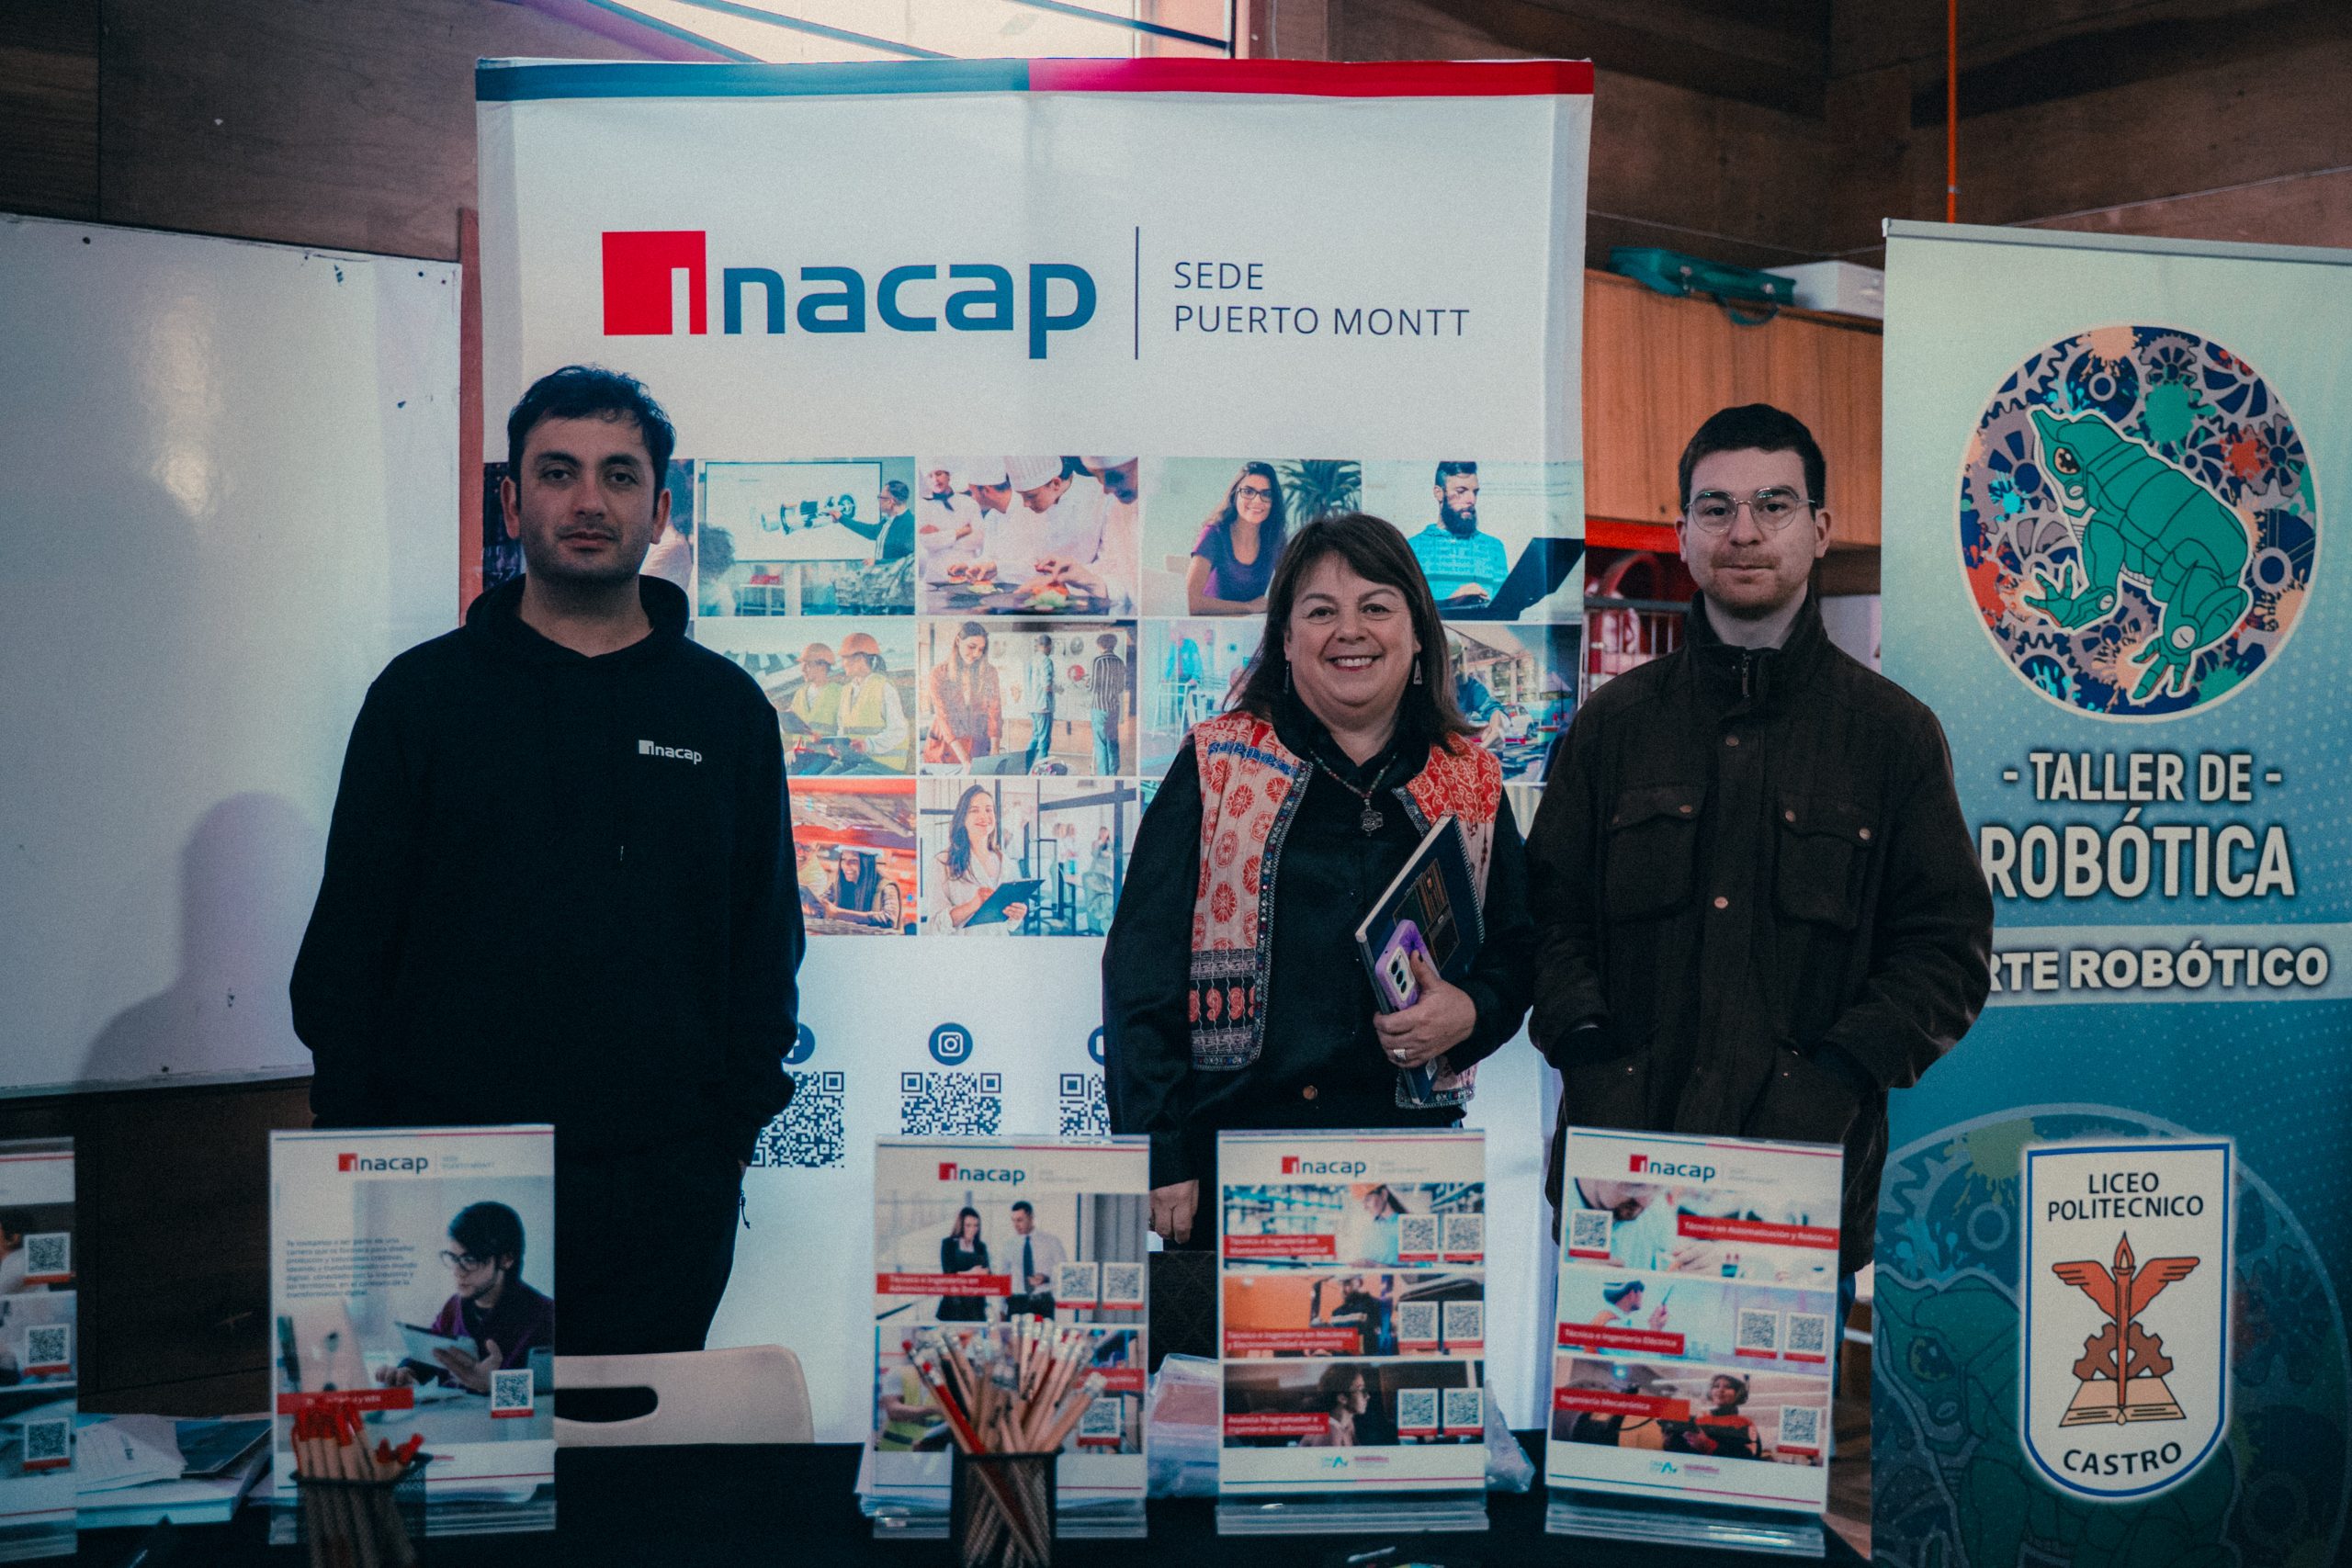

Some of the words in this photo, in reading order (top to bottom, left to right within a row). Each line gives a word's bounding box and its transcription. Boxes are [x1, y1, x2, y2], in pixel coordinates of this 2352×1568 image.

[1174, 261, 1264, 291] SEDE
[1174, 304, 1318, 335] PUERTO
[1334, 306, 1469, 337] MONTT
[2030, 752, 2184, 801] TALLER
[2199, 754, 2252, 802] DE
[1981, 807, 2295, 898] ROBÓTICA
[1990, 952, 2059, 992] RTE
[2070, 941, 2328, 989] ROBÓTICO
[2088, 1172, 2159, 1194] LICEO
[2048, 1196, 2204, 1222] POLITECNICO
[2064, 1441, 2182, 1476] CASTRO
